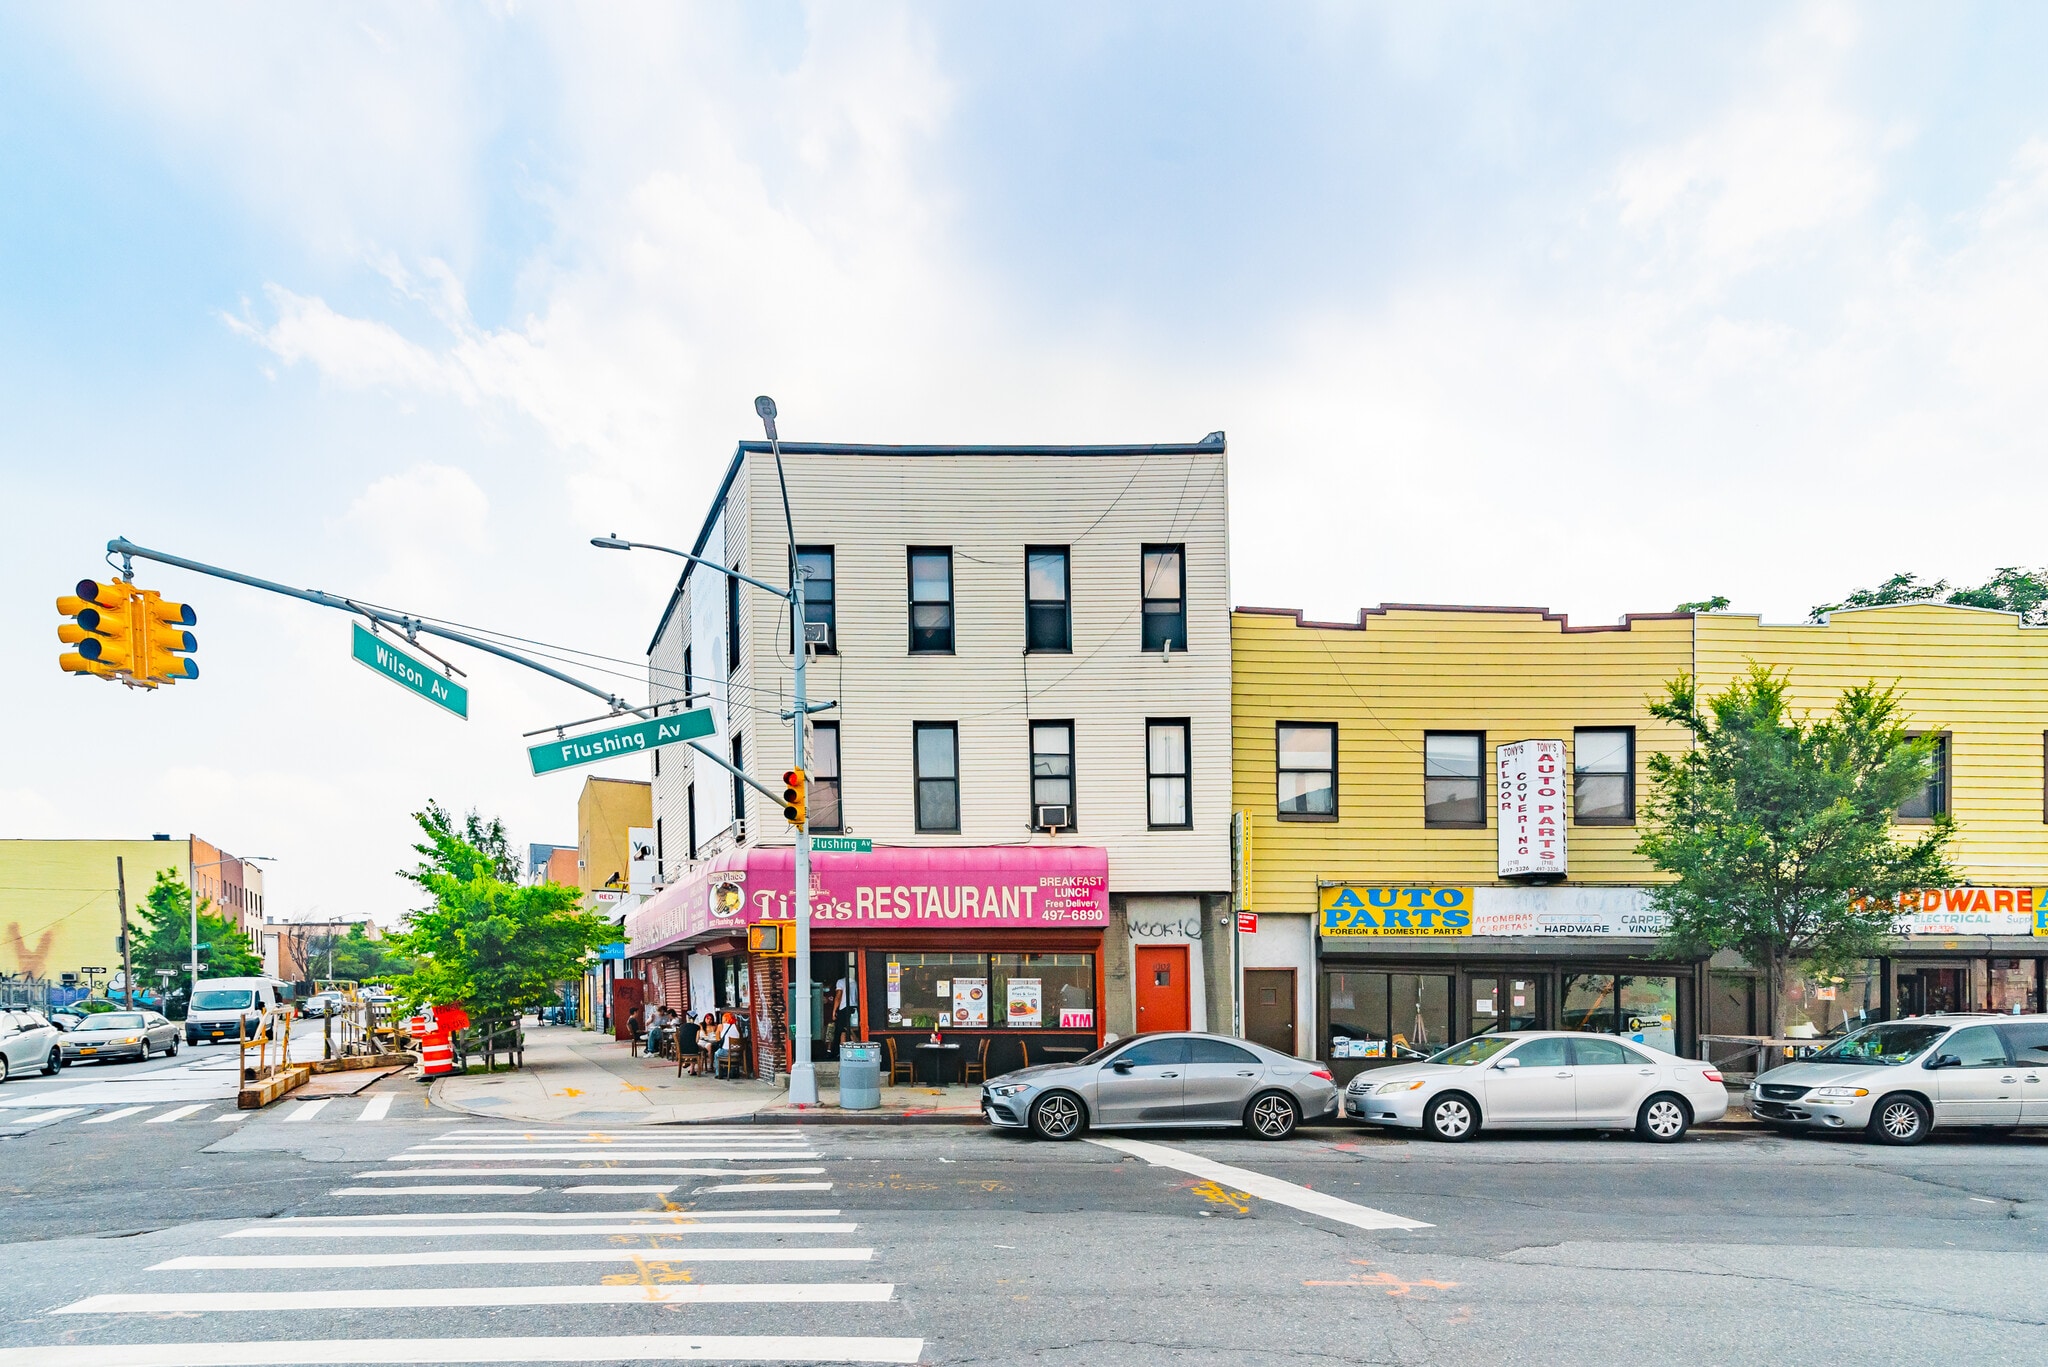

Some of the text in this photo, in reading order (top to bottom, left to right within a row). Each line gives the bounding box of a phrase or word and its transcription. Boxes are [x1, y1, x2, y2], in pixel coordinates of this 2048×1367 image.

[376, 644, 448, 700] Wilson Av
[561, 723, 681, 762] Flushing Av
[1536, 743, 1556, 752] TONY'S
[1503, 744, 1523, 757] TONY'S
[1501, 760, 1512, 811] FLOOR
[1538, 753, 1557, 860] AUTO PARTS
[1517, 772, 1528, 855] COVERING
[812, 838, 857, 851] Flushing
[1039, 877, 1103, 887] BREAKFAST
[1055, 887, 1090, 898] LUNCH
[1331, 888, 1464, 907] AUTO
[752, 886, 1038, 920] Tia's RESTAURANT
[1045, 899, 1099, 910] Free Delivery
[1042, 909, 1103, 921] 497-6890
[1323, 909, 1471, 928] PARTS
[1475, 913, 1533, 924] ALFOMBRAS
[1914, 914, 1990, 924] ELECTRICAL
[2006, 913, 2032, 925] Supp
[1544, 925, 1610, 933] HARDWARE
[941, 1014, 949, 1022] A
[1062, 1013, 1092, 1027] ATM
